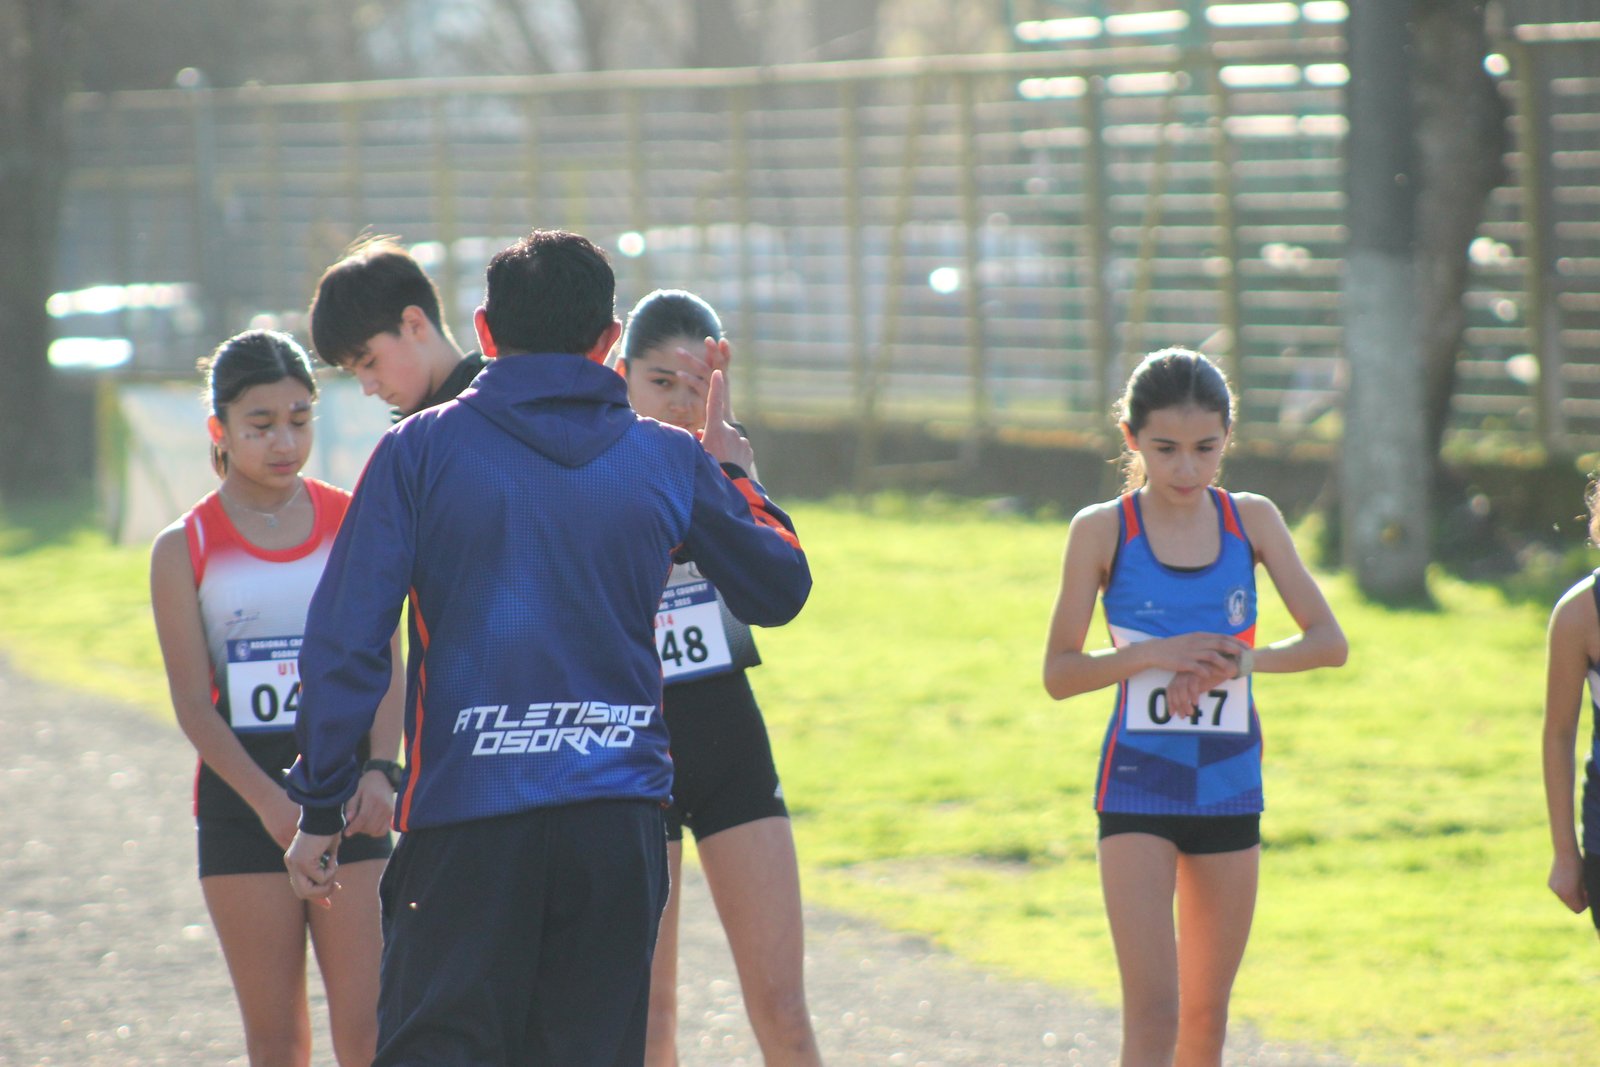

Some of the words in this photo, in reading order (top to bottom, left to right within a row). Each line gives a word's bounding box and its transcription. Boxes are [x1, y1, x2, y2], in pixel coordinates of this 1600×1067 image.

[676, 584, 707, 595] COUNTRY
[251, 640, 288, 648] REGIONAL
[472, 724, 636, 756] OSORNO
